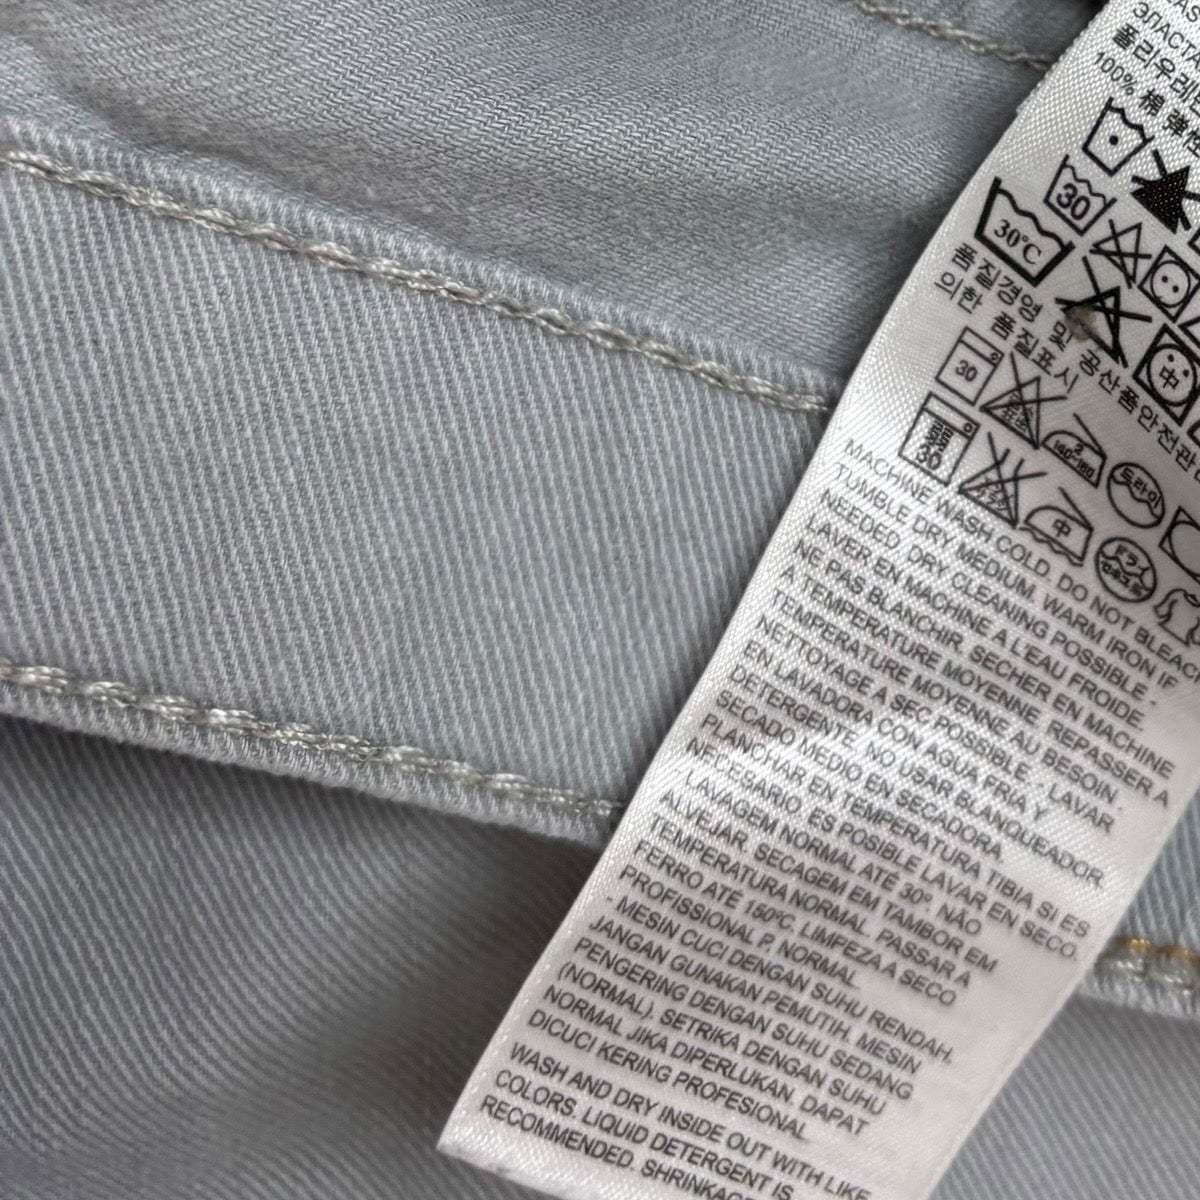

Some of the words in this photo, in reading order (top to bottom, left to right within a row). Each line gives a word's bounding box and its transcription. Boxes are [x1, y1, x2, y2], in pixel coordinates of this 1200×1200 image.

[1093, 52, 1138, 96] 100%
[934, 271, 984, 315] 의한
[952, 242, 1044, 324] 품질경영
[805, 513, 873, 568] LAVER
[904, 575, 993, 639] MACHINE
[1010, 637, 1069, 681] L'EAU
[833, 462, 912, 526] TUMBLE
[911, 514, 957, 549] DRY
[1043, 593, 1106, 644] WARM
[1105, 636, 1158, 679] IRON
[1157, 671, 1180, 691] IF
[844, 438, 933, 505] MACHINE
[936, 496, 995, 545] WASH
[1056, 573, 1089, 602] DO
[1089, 595, 1135, 632] NOT
[771, 588, 914, 683] TEMPERATURE
[910, 674, 1011, 739] MOYENNE
[1010, 730, 1042, 757] AU
[801, 573, 944, 672] TEMPERATURE
[1045, 719, 1155, 797] REPASSER
[825, 558, 867, 596] PAS
[968, 644, 1052, 702] SECHER
[1083, 711, 1177, 781] MACHINE
[907, 544, 950, 579] DRY
[950, 571, 1050, 641] CLEANING
[1050, 630, 1149, 701] POSSIBLE
[716, 689, 797, 747] SECADO
[799, 737, 864, 783] MEDIO
[757, 614, 875, 696] NETTOYAGE
[890, 694, 933, 725] SEC
[1048, 782, 1115, 833] LAVAR
[774, 659, 875, 727] LAVADORA
[877, 717, 924, 752] CON
[926, 743, 980, 785] AGUA
[982, 775, 1027, 814] FRIA
[898, 757, 954, 799] USAR
[685, 769, 781, 836] LAVAGEM
[778, 826, 859, 874] NORMAL
[701, 712, 808, 786] PLANCHAR
[842, 792, 983, 879] TEMPERATURA
[986, 867, 1035, 910] TIBIA
[838, 821, 923, 875] POSIBLE
[920, 863, 989, 912] LAVAR
[616, 895, 681, 940] MESIN
[680, 928, 731, 960] CUCI
[727, 949, 812, 994] DENGAN
[618, 864, 756, 946] PROFISSIONAL
[635, 839, 706, 890] FERRO
[798, 919, 883, 971] LIMPEZA
[897, 967, 957, 1008] SECO
[648, 813, 790, 900] TEMPERATURA
[875, 927, 957, 981] PASSAR
[753, 842, 850, 897] SECAGEM
[884, 901, 965, 957] TAMBOR
[528, 1008, 600, 1053] DICUCI
[596, 1040, 674, 1085] KERING
[542, 983, 623, 1037] NORMAL
[626, 1025, 670, 1055] JIKA
[799, 1094, 870, 1138] DAPAT
[574, 936, 690, 1003] PENGERING
[688, 989, 773, 1036] DENGAN
[829, 1048, 915, 1102] SEDANG
[589, 915, 671, 966] JANGAN
[669, 953, 764, 1003] GUNAKAN
[855, 1032, 923, 1076] MESIN
[659, 1007, 742, 1053] SETRIKA
[741, 1039, 828, 1090] DENGAN
[495, 1069, 579, 1120] COLORS.
[581, 1105, 650, 1146] LIQUID
[649, 1132, 774, 1193] DETERGENT
[509, 1040, 570, 1083] WASH
[567, 1070, 614, 1101] AND
[612, 1087, 660, 1119] DRY
[658, 1104, 728, 1144] INSIDE
[726, 1130, 773, 1162] OUT
[771, 1149, 826, 1187] WITH
